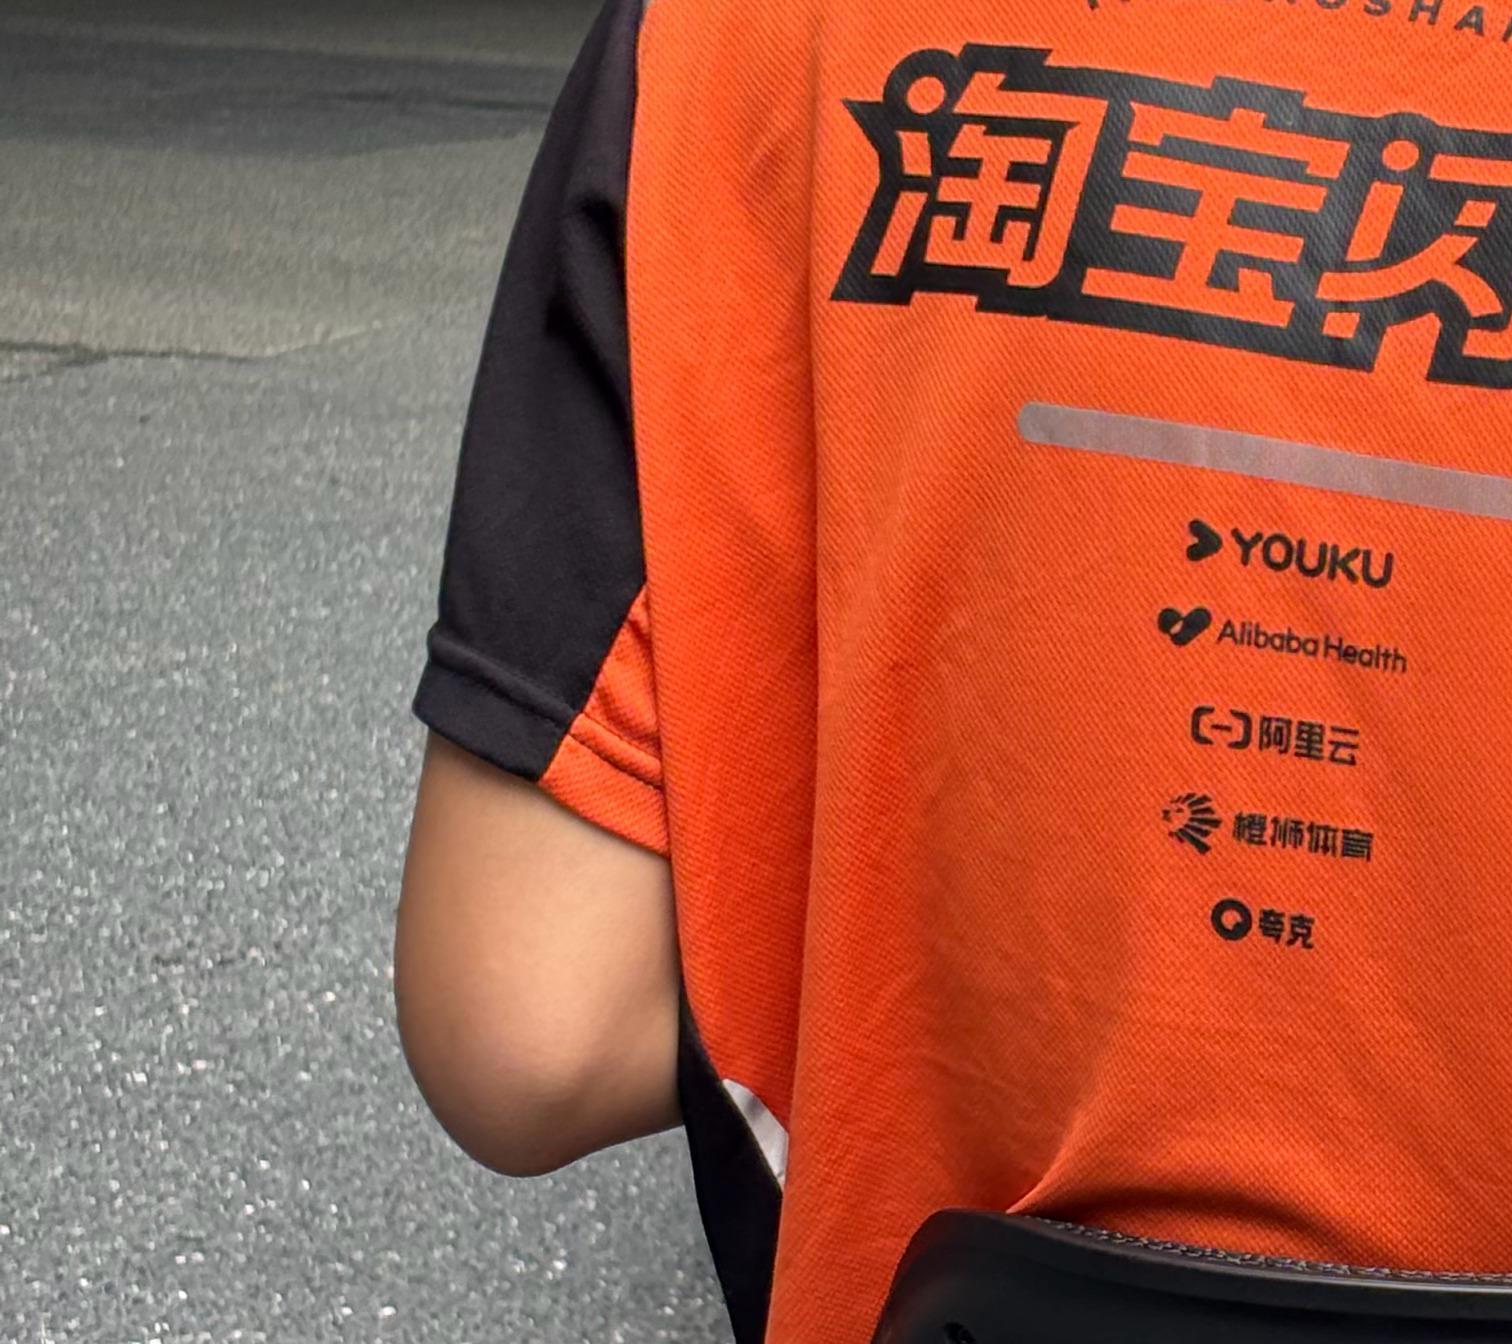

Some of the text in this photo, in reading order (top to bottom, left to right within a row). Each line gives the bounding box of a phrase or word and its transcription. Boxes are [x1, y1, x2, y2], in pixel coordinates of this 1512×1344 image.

[1231, 527, 1394, 588] YOUKU
[1216, 618, 1407, 673] Alibaba Health
[1258, 715, 1359, 766] 阿里云
[1233, 812, 1373, 862] 橙狮体育
[1259, 908, 1315, 949] 夸克
